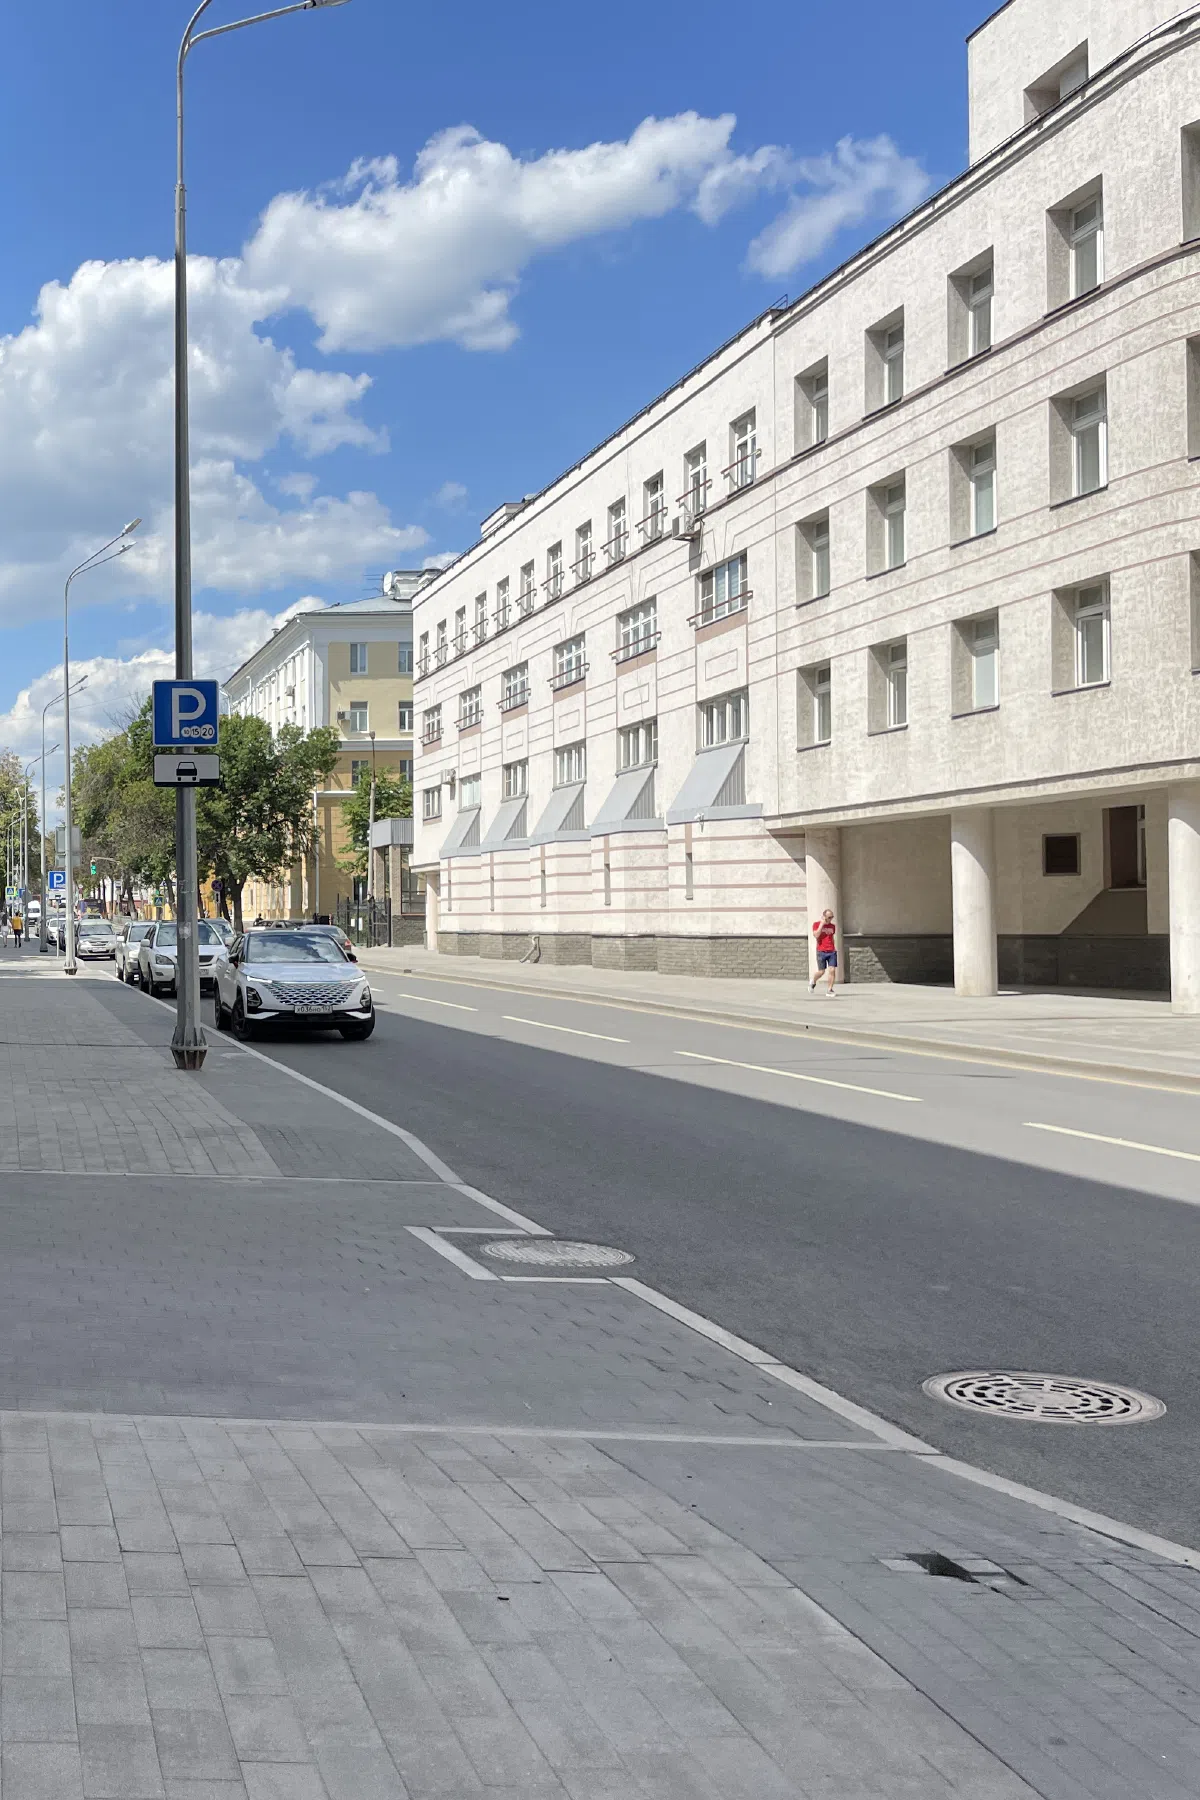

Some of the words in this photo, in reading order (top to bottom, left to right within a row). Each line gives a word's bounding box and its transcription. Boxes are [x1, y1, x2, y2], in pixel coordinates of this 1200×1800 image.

[172, 688, 206, 738] P
[192, 728, 200, 736] 15
[202, 728, 213, 736] 20
[54, 873, 64, 888] P
